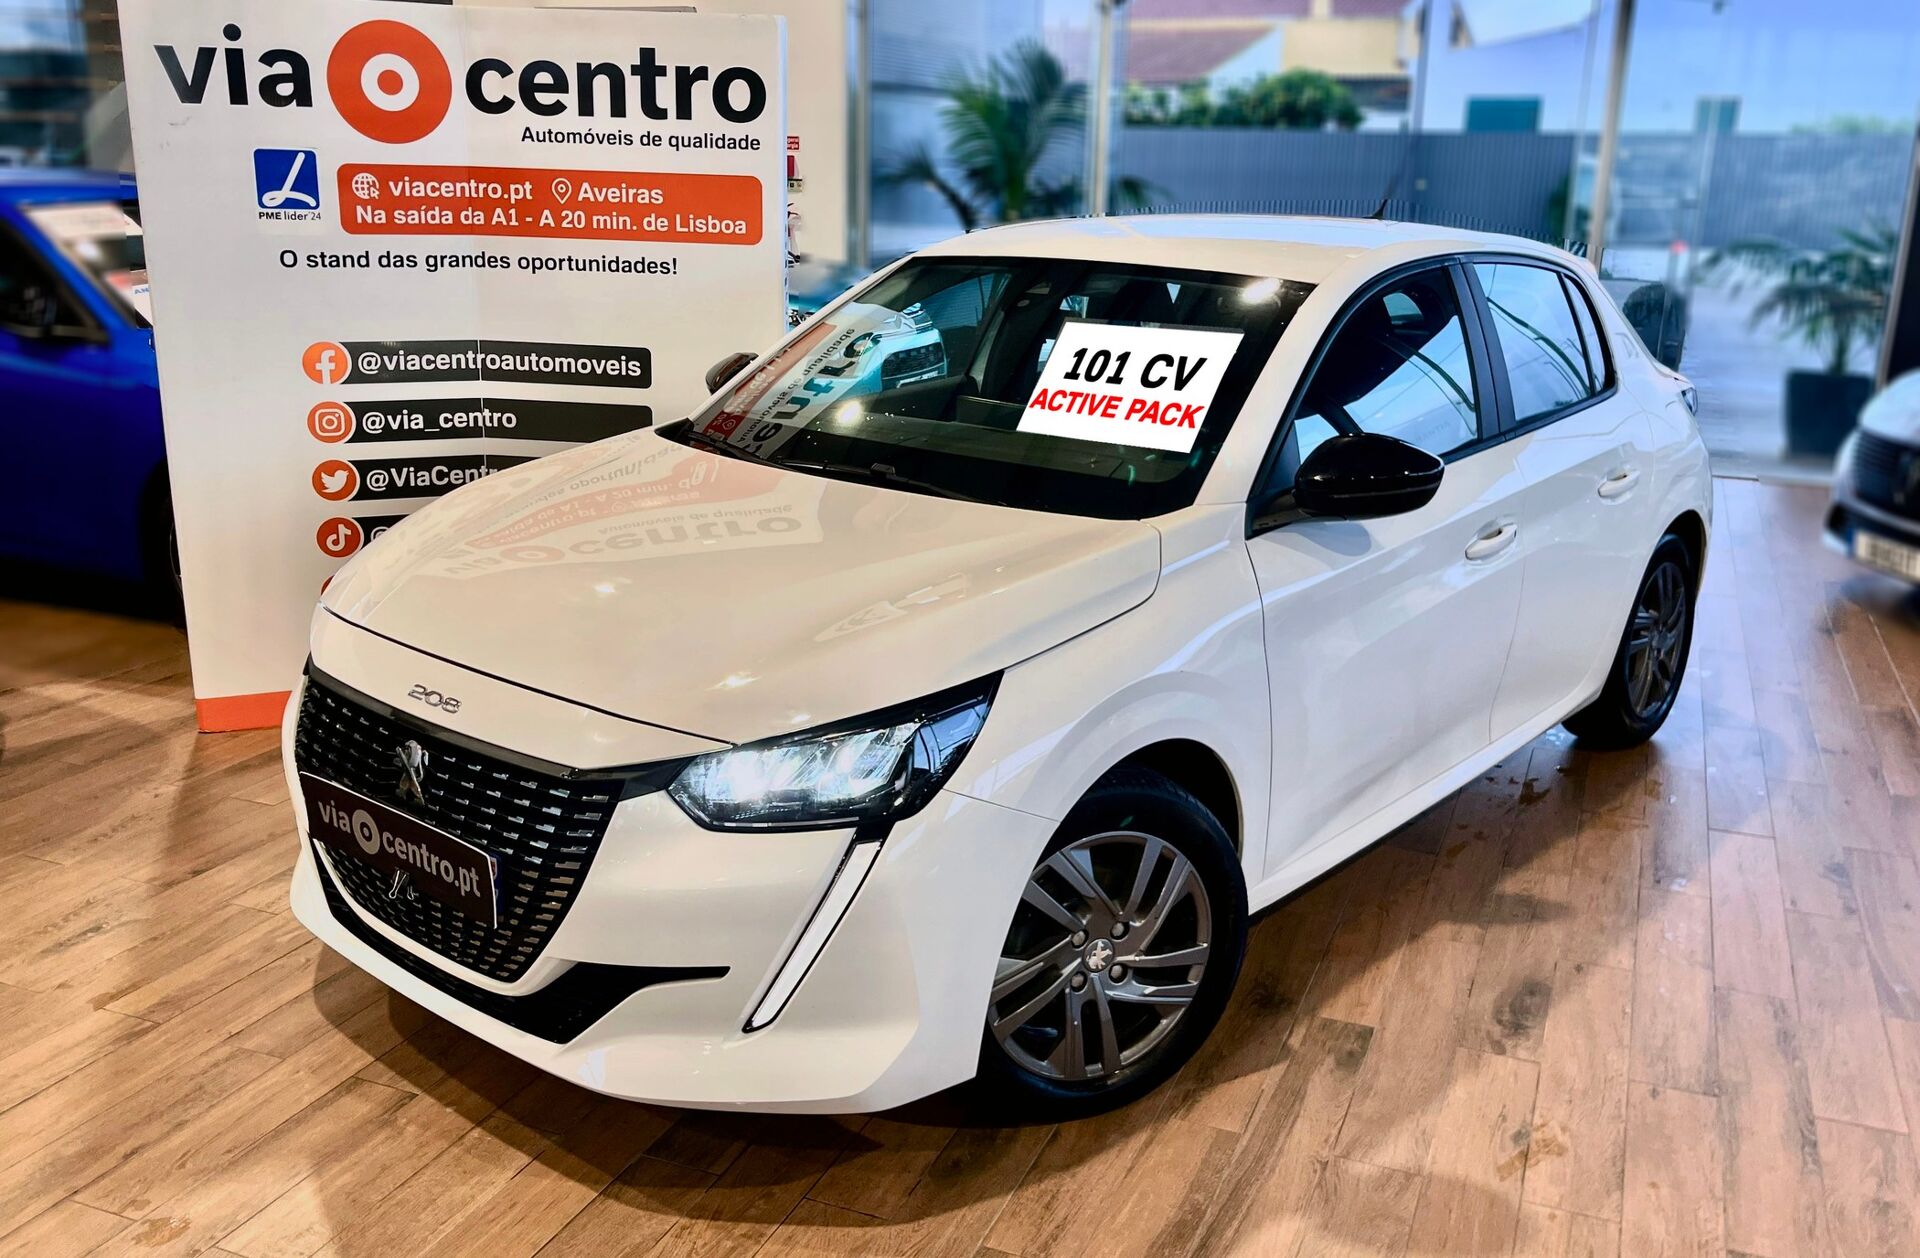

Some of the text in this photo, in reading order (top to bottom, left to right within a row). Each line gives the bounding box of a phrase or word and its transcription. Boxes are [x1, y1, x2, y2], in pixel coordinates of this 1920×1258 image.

[153, 23, 767, 124] via centro
[521, 126, 761, 152] Automóveis de qualidade
[388, 176, 664, 205] viacentro.pt Aveiras
[258, 211, 282, 221] PME
[355, 205, 387, 225] Na
[393, 203, 453, 225] saída
[459, 205, 485, 225] da
[491, 207, 519, 226] A1
[538, 209, 555, 228] A
[561, 210, 586, 229] 20
[592, 212, 637, 231] min.
[642, 213, 669, 232] de
[675, 214, 747, 235] Lisboa
[279, 249, 678, 275] O stand das grandes oportunidades!
[357, 350, 642, 377] @viacentroautomoveis
[1063, 347, 1208, 392] 101 CV
[362, 407, 517, 435] @via_centro
[1029, 388, 1205, 429] ACTIVE PACK
[407, 683, 462, 714] 208
[317, 799, 481, 898] via centro.pt
